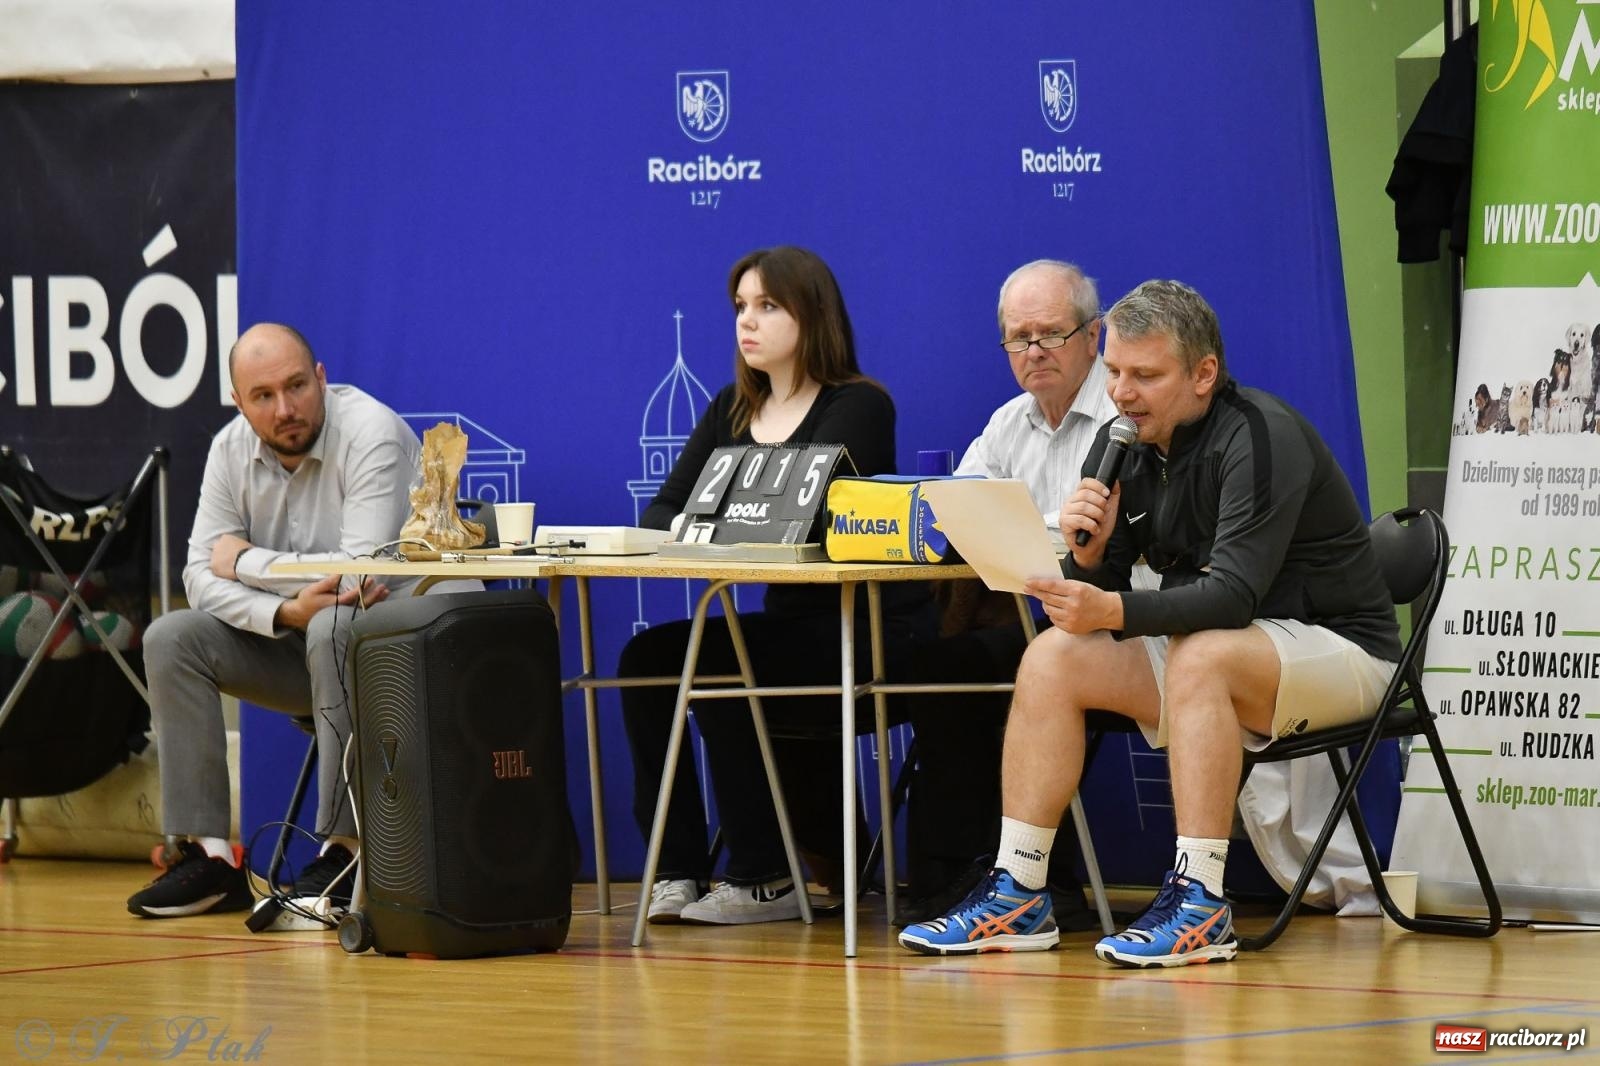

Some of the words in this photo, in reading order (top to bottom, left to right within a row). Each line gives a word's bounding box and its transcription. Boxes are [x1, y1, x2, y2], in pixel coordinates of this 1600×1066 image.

[648, 155, 761, 182] Racibórz
[1021, 146, 1102, 173] Racibórz
[691, 191, 721, 209] 1217
[1053, 183, 1075, 201] 1217
[1484, 203, 1600, 244] WWW.ZOO
[0, 223, 238, 408] IBÓ
[1462, 460, 1520, 488] Dzielimy
[1523, 461, 1544, 490] się
[1547, 466, 1586, 491] naszą
[724, 503, 769, 517] JOOLA
[1521, 493, 1540, 516] od
[1544, 493, 1579, 517] 1989
[833, 513, 899, 534] MIKASA
[1462, 609, 1524, 637] DŁUGA
[1535, 611, 1556, 638] 10
[1496, 650, 1600, 679] SŁOWACKIE
[1461, 690, 1550, 718] OPAWSKA
[1558, 692, 1581, 719] 82
[1522, 732, 1595, 760] RUDZKA
[492, 750, 533, 779] JBL
